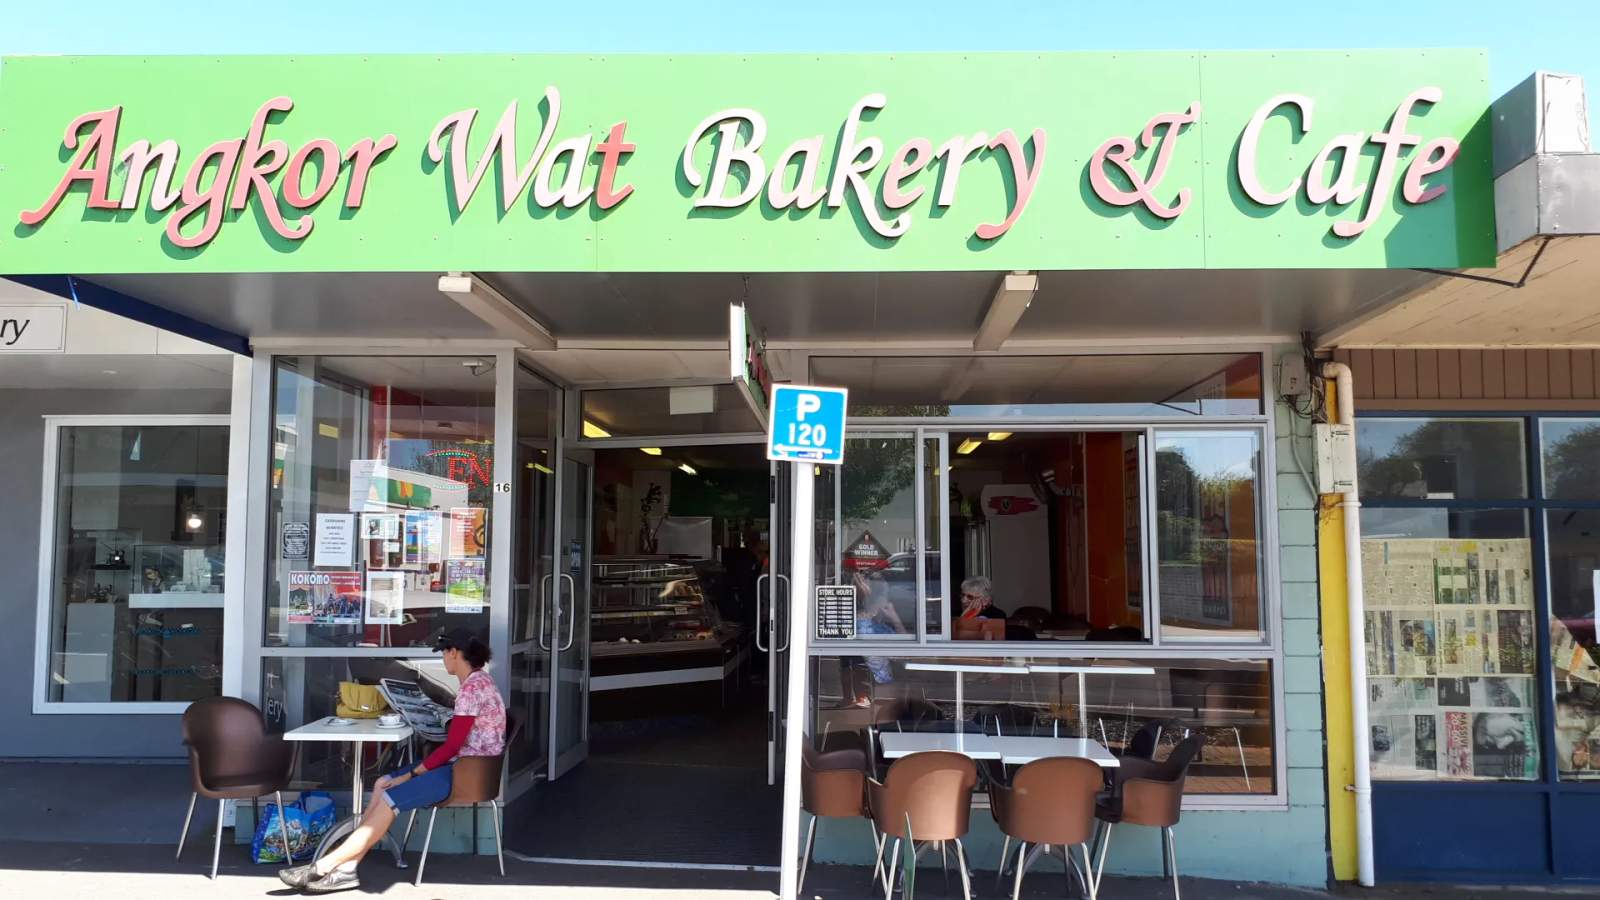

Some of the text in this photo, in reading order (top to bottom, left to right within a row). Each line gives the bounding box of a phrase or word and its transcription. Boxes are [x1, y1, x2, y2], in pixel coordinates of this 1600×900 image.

[20, 86, 1460, 248] Angkor Wat Bakery & Cafe
[0, 319, 31, 346] ry
[797, 393, 821, 421] P
[789, 423, 826, 447] 120
[496, 483, 511, 493] 16
[291, 574, 330, 585] KOKOMO
